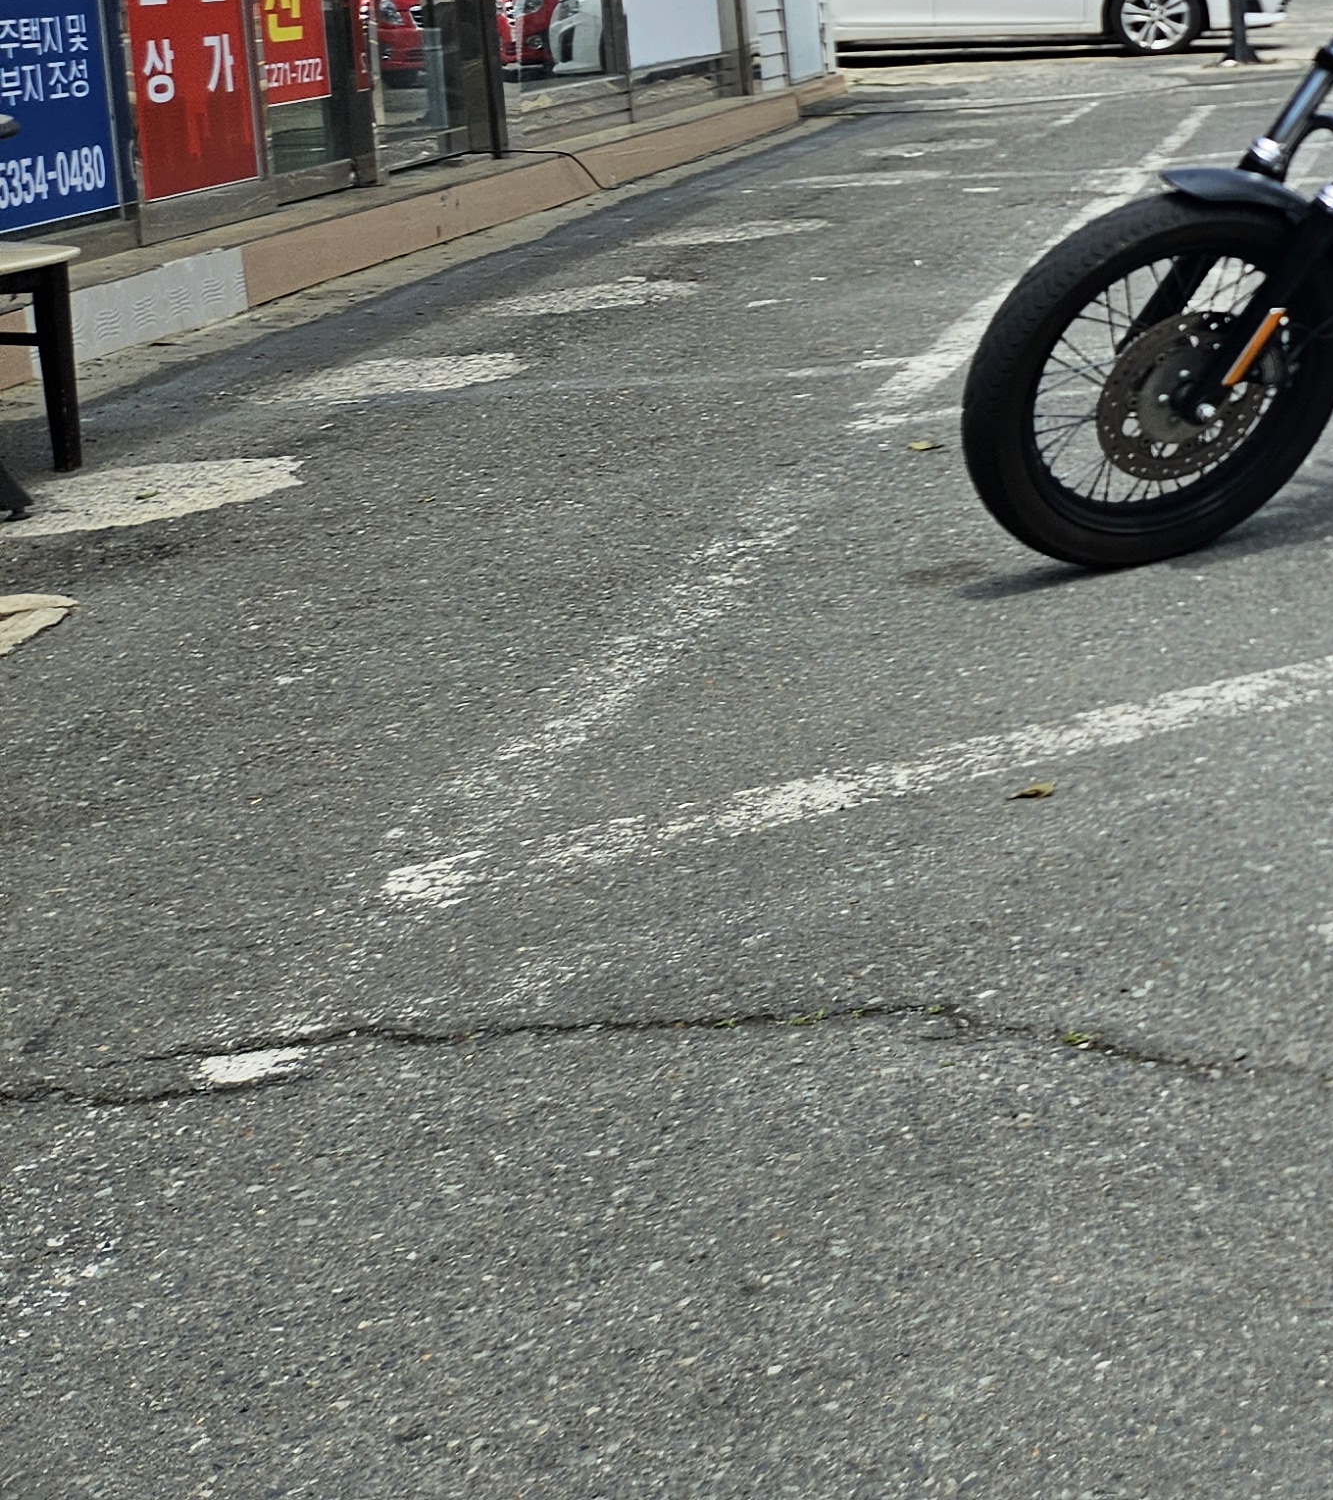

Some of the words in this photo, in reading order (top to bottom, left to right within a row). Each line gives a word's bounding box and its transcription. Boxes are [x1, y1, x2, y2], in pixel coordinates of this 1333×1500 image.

[65, 13, 89, 53] 및
[1, 62, 45, 107] 부지
[46, 58, 91, 100] 조성
[143, 33, 235, 105] 상가
